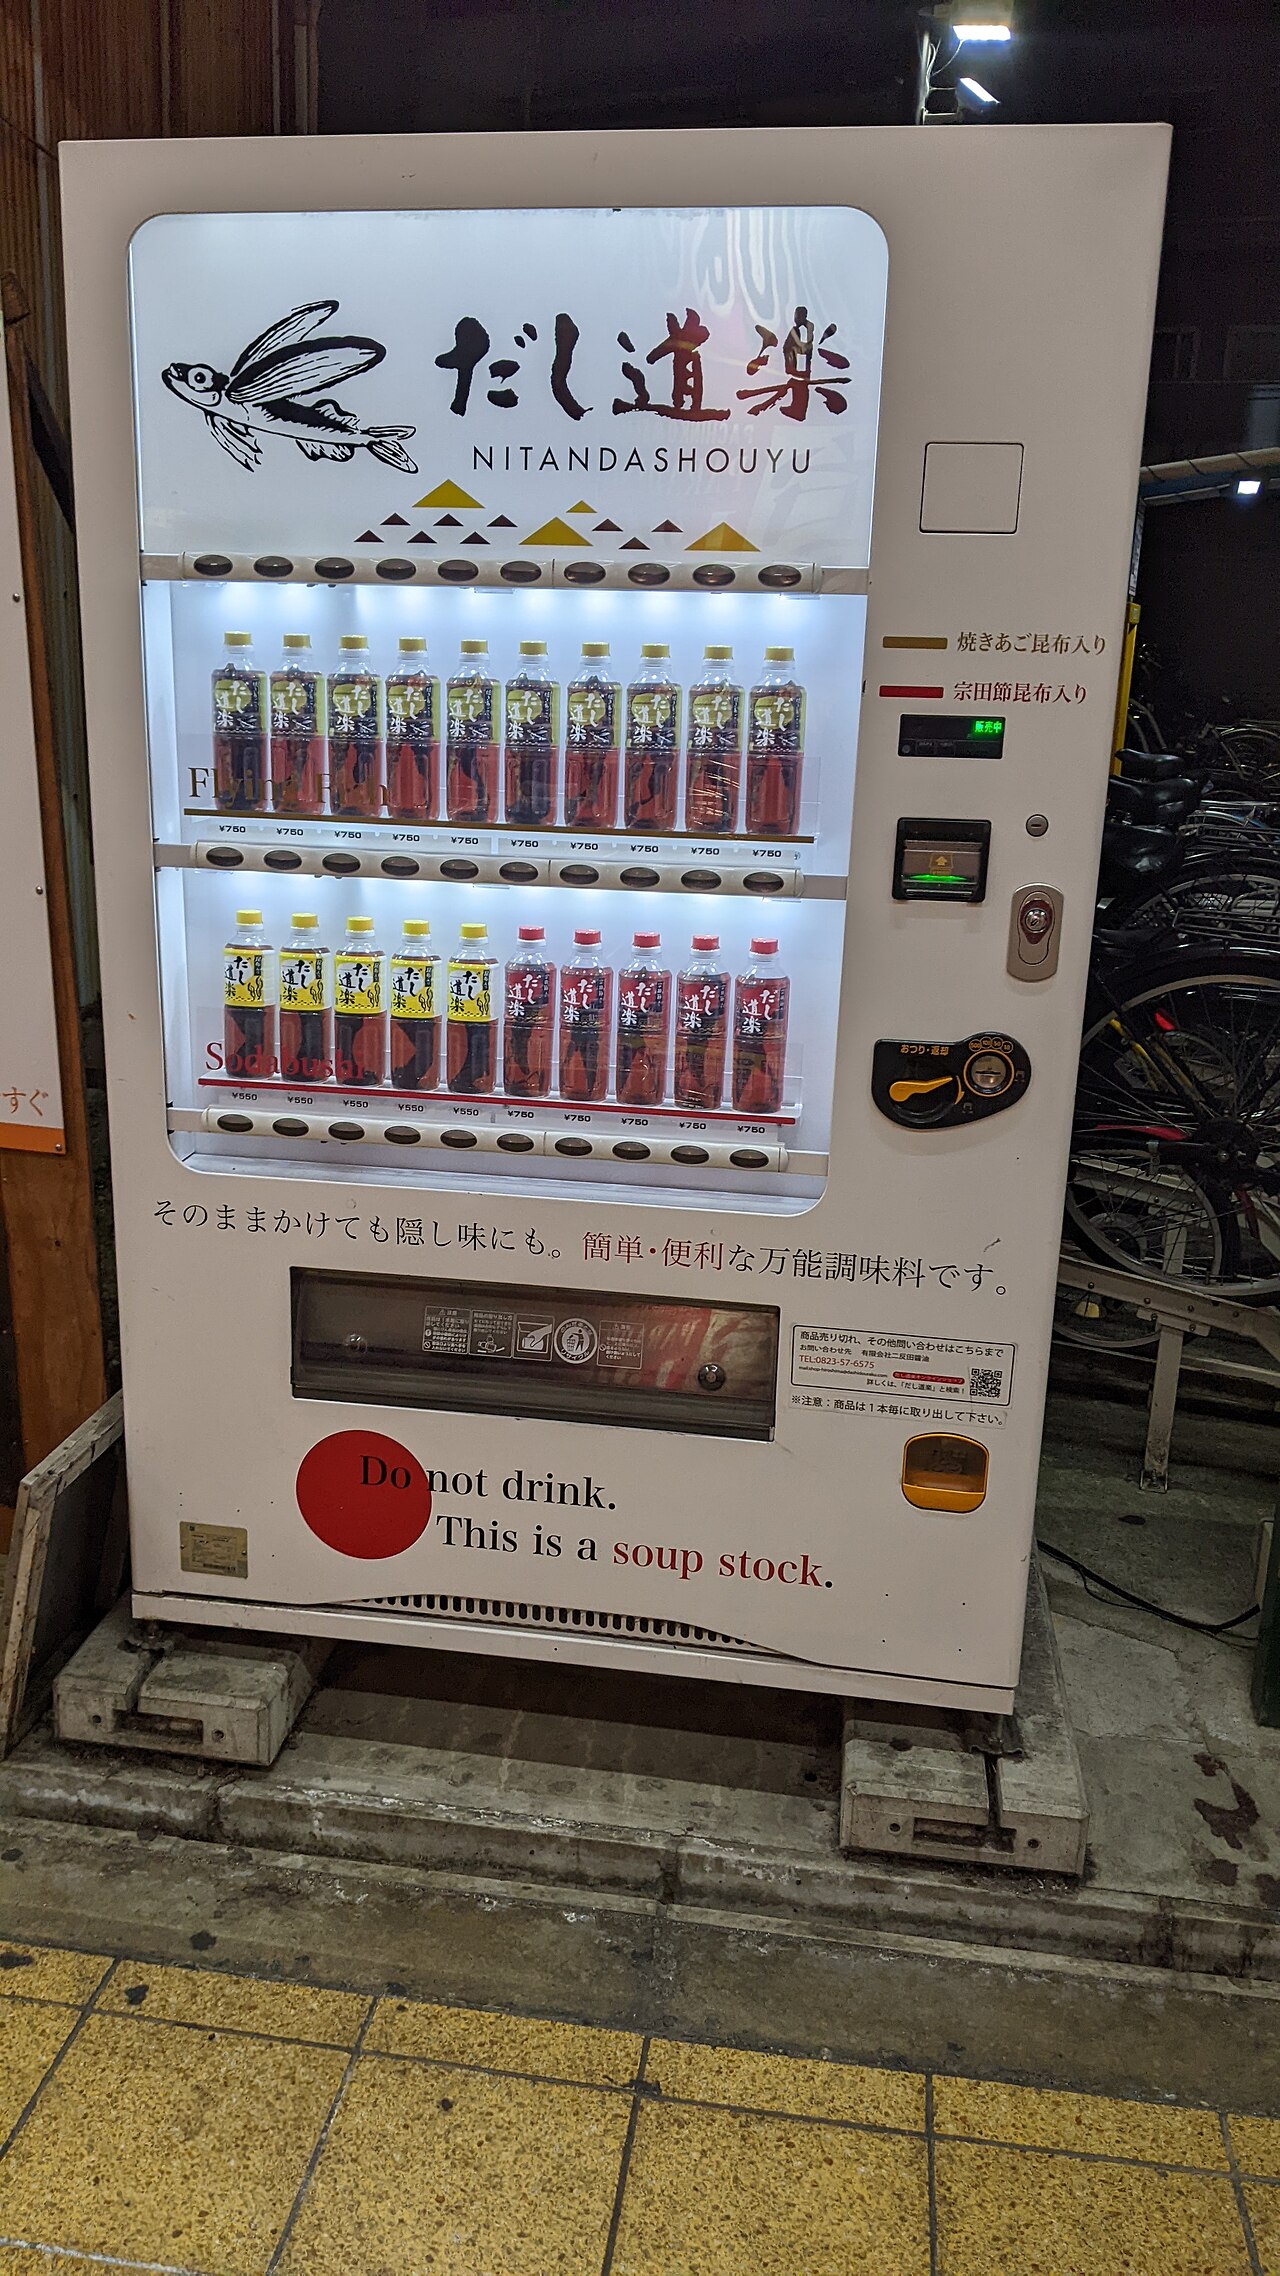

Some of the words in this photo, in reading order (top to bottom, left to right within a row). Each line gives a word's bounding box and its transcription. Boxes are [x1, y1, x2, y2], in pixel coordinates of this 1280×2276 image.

[435, 306, 852, 422] だし道楽
[472, 446, 812, 474] NITANDASHOUYU
[957, 631, 1106, 654] 焼きあご昆布入り
[953, 681, 1087, 704] 宗田節昆布入り
[975, 720, 1002, 733] 販売中
[218, 825, 247, 834] ¥750
[276, 828, 304, 836] ¥750
[334, 831, 362, 839] ¥750
[392, 834, 420, 842] ¥750
[450, 837, 479, 845] ¥750
[510, 840, 539, 848] ¥750
[570, 842, 598, 850] ¥750
[630, 845, 659, 853] ¥750
[691, 847, 720, 856] ¥750
[752, 850, 782, 858] ¥750
[900, 1044, 949, 1056] おつり・返却
[232, 1092, 258, 1101] ¥550
[287, 1096, 313, 1105] ¥550
[343, 1100, 369, 1108] ¥550
[398, 1104, 424, 1112] ¥550
[453, 1107, 479, 1116] ¥550
[507, 1110, 534, 1119] ¥750
[564, 1114, 591, 1122] ¥750
[621, 1118, 649, 1126] ¥750
[679, 1122, 706, 1130] ¥750
[737, 1125, 765, 1134] ¥750
[359, 1454, 413, 1490] Do
[425, 1463, 488, 1497] not
[502, 1469, 617, 1511] drink.
[436, 1514, 518, 1553] This
[532, 1524, 563, 1558] is
[577, 1537, 598, 1562] a
[612, 1540, 704, 1577] soup
[718, 1548, 834, 1589] stock.
